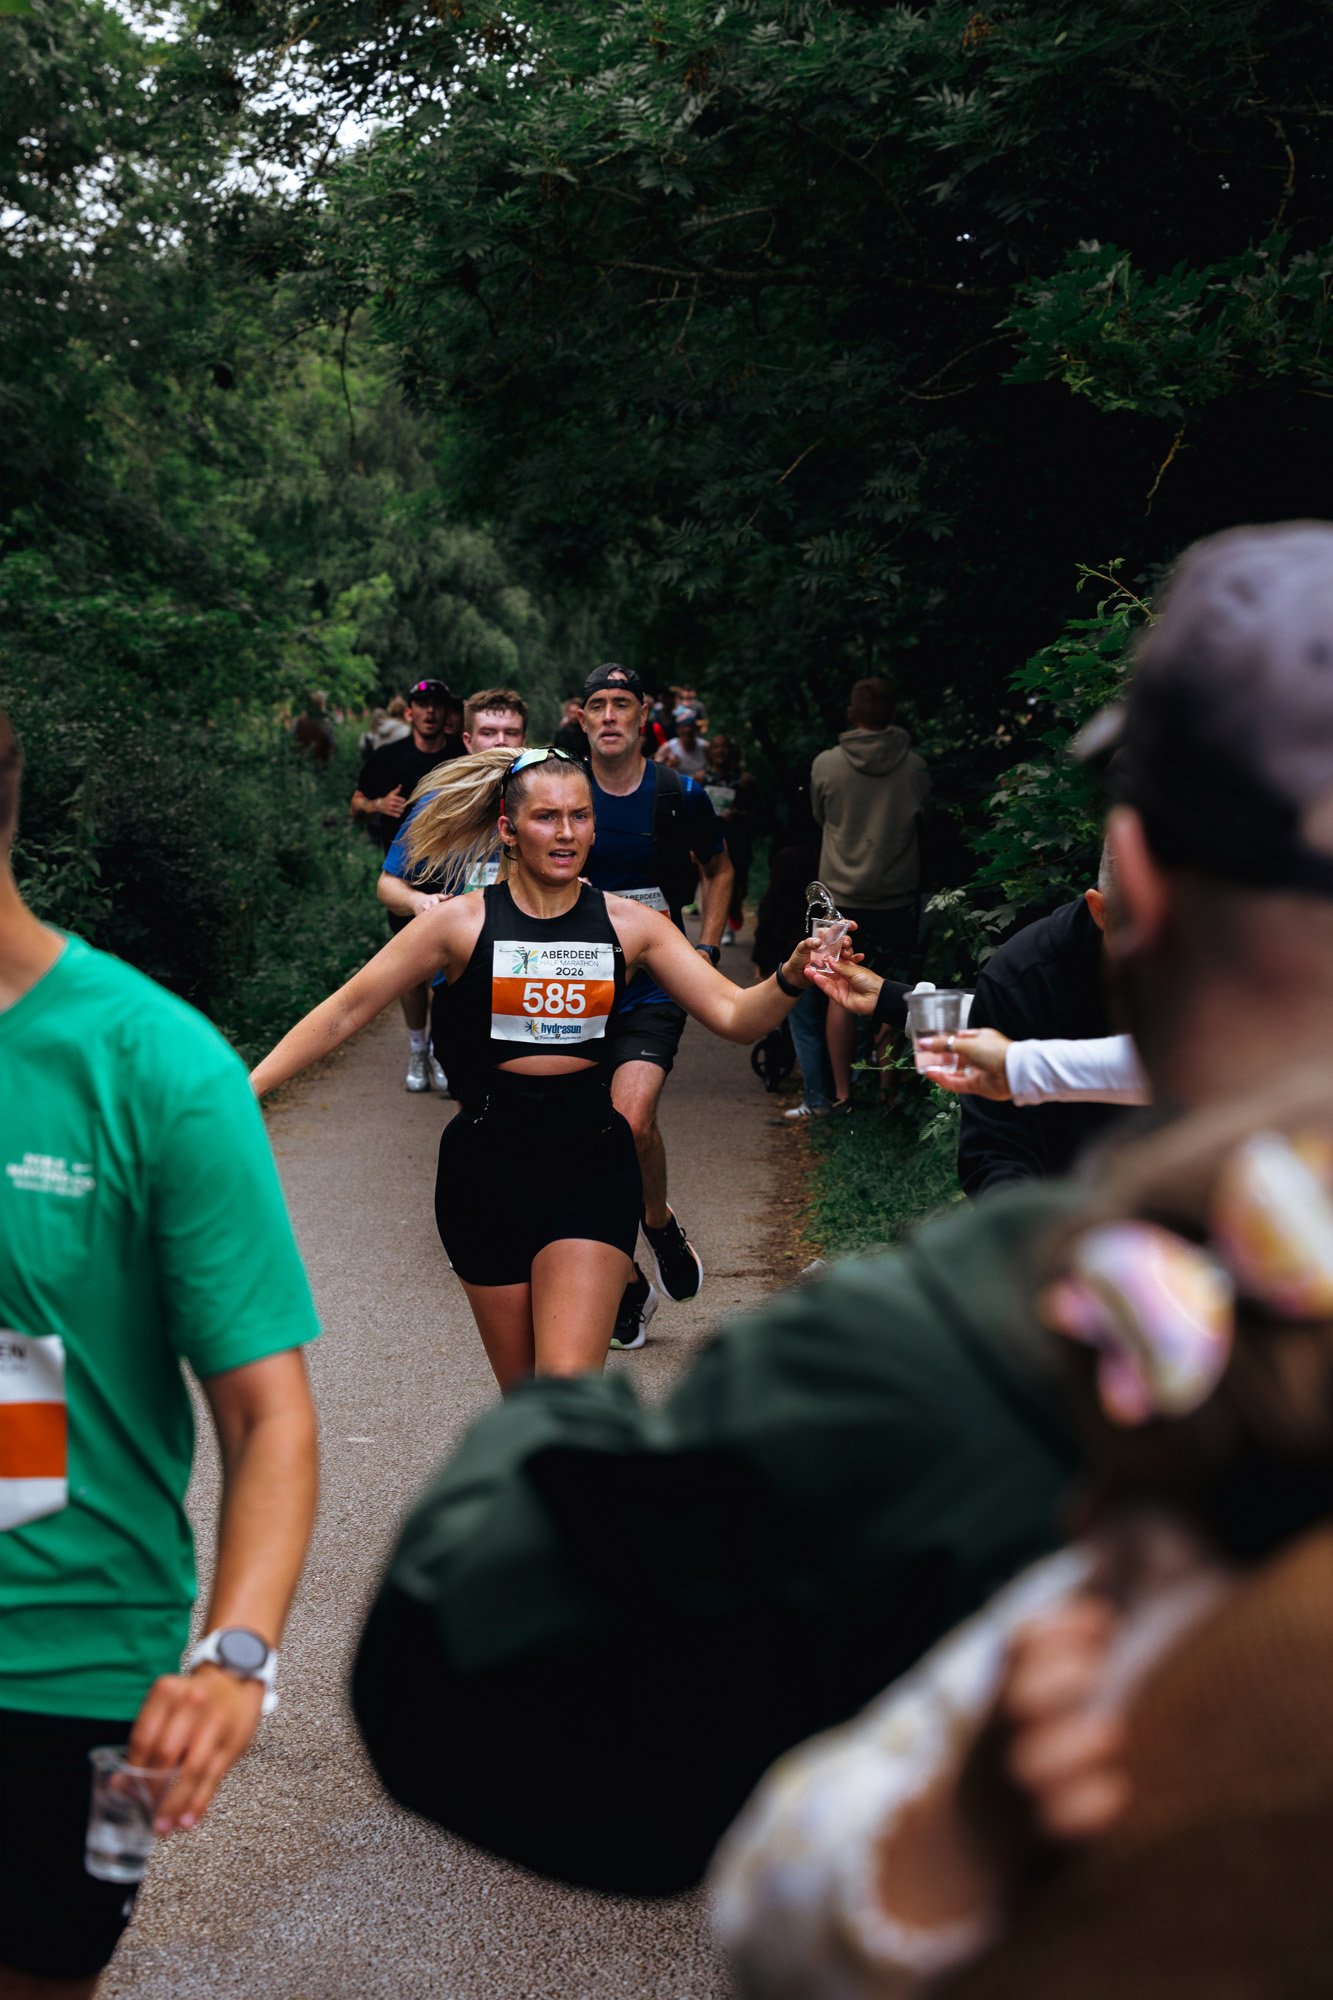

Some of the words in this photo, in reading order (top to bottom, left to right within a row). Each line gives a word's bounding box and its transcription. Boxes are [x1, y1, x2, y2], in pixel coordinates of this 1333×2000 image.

[541, 950, 598, 959] ABERDEEN
[555, 967, 584, 976] 2026
[522, 982, 586, 1015] 585
[541, 1022, 582, 1034] hydrasun
